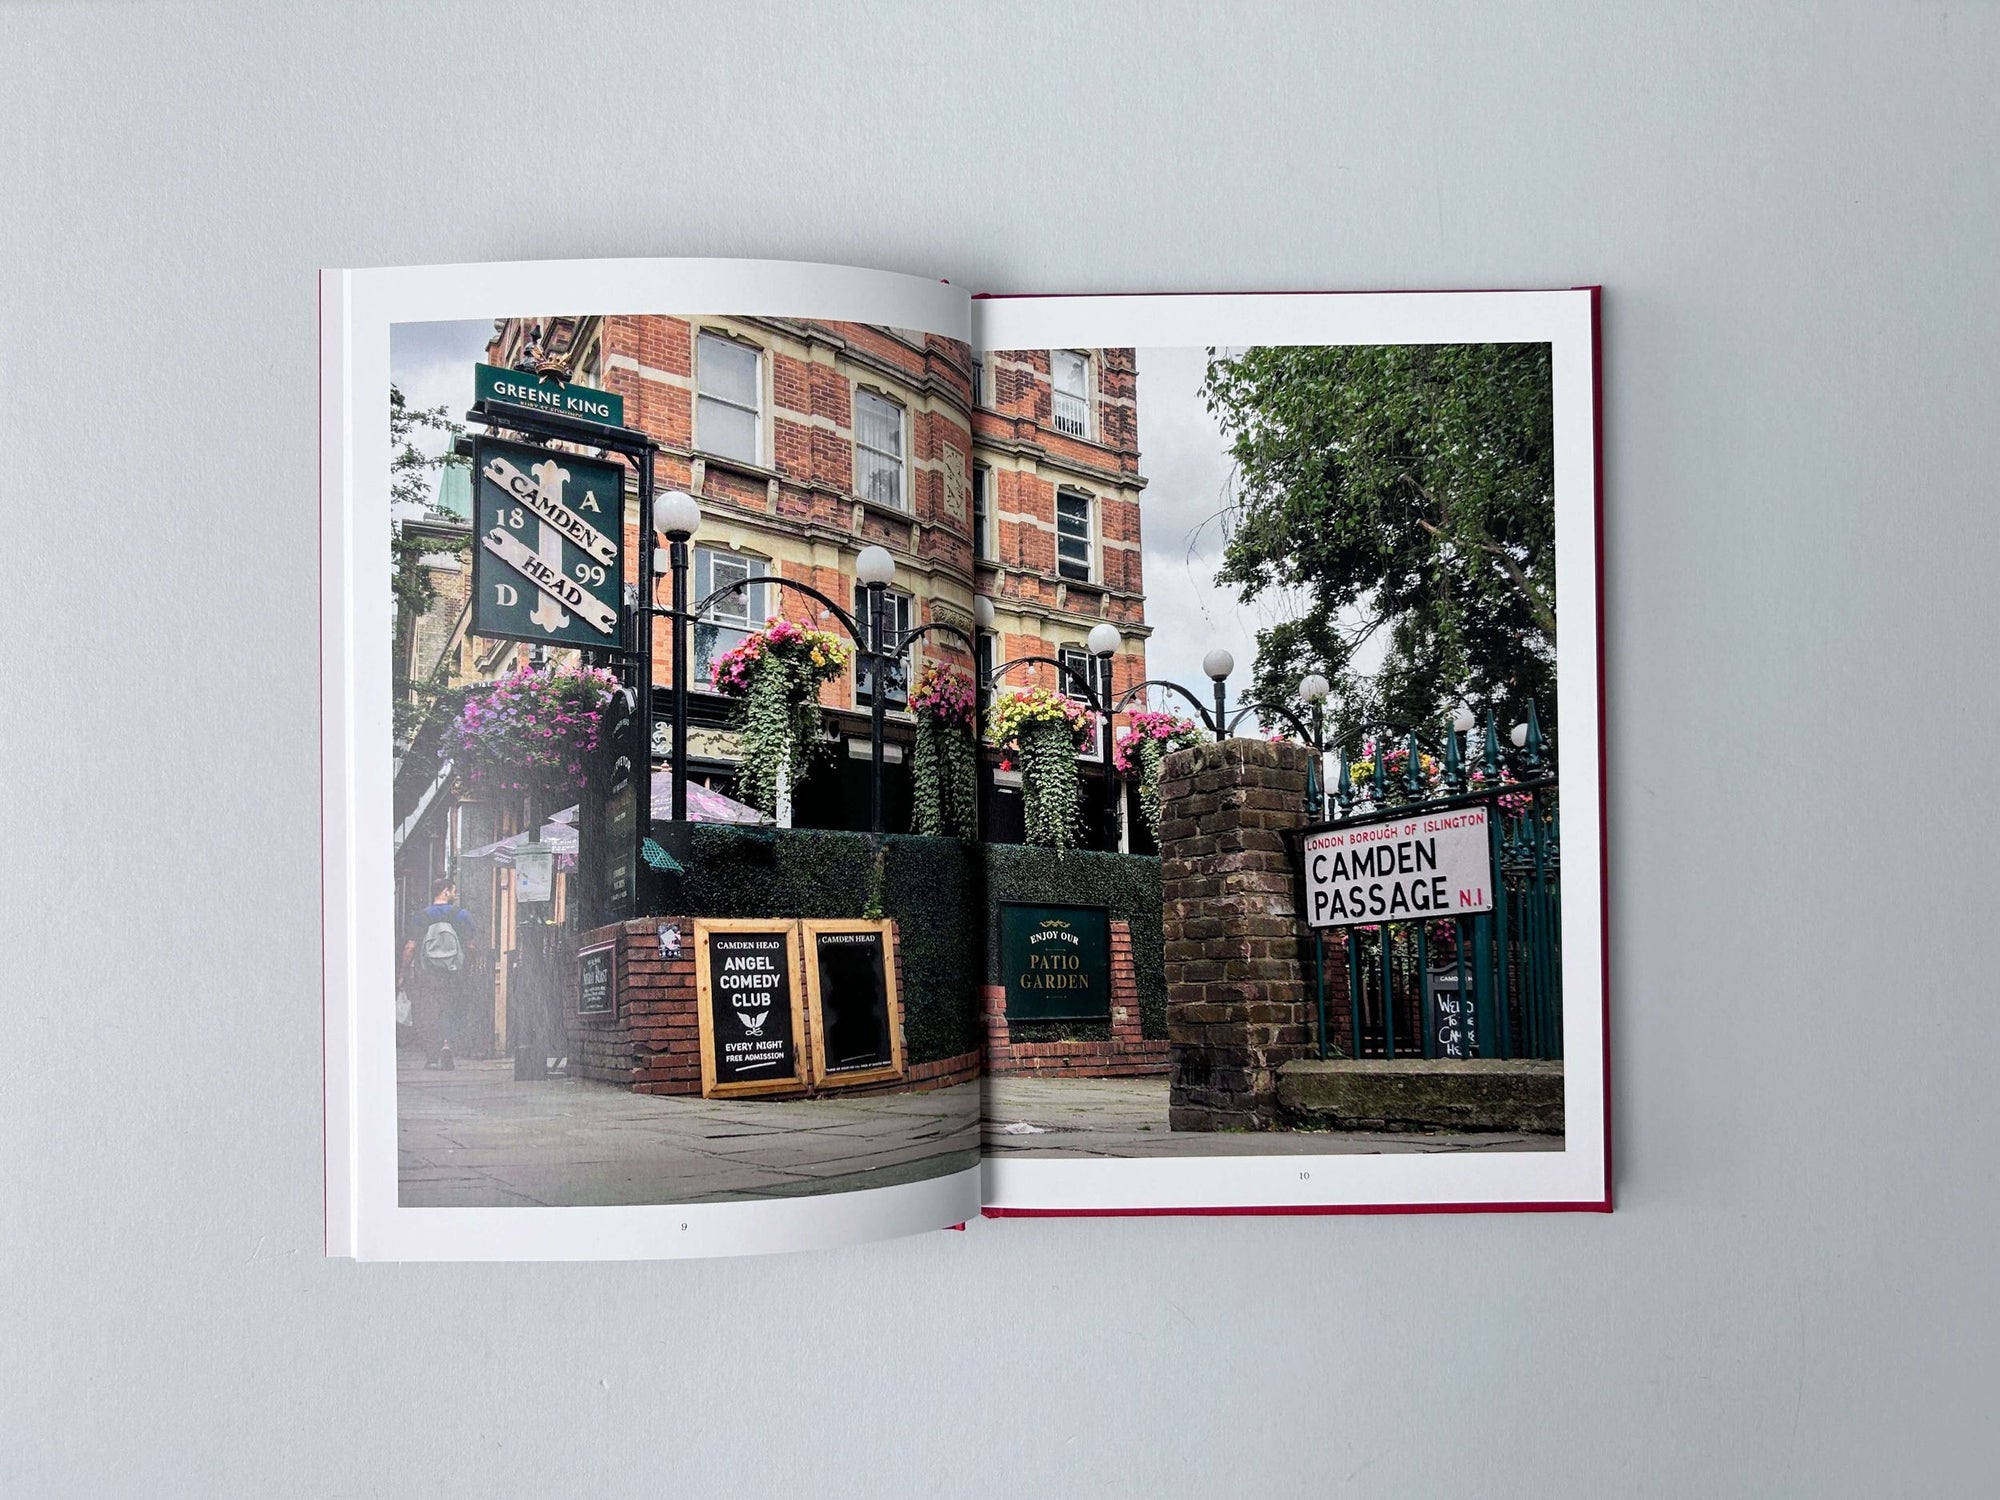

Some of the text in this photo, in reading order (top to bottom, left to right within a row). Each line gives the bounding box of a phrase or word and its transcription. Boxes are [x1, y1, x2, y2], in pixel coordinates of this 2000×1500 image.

[493, 381, 610, 418] GREENE KING
[579, 490, 602, 513] A
[495, 506, 525, 530] 18
[510, 475, 599, 548] CAMDEN
[521, 555, 583, 606] HEAD
[575, 563, 606, 587] 99
[495, 583, 519, 607] D
[1307, 813, 1485, 851] LONDON BOROUGH OF ISLINGTON
[1312, 837, 1437, 884] CAMDEN
[1313, 876, 1450, 921] PASSAGE
[716, 940, 780, 950] CAMDEN HEAD
[822, 934, 876, 943] CAMDEN HEAD
[1029, 930, 1080, 946] ENJOY OUR
[723, 956, 775, 971] ANGEL
[1029, 954, 1080, 970] PATIO
[719, 972, 781, 989] COMEDY
[1020, 974, 1090, 989] GARDEN
[731, 992, 772, 1007] CLUB
[725, 1040, 784, 1052] EVERY NIGHT
[726, 1052, 785, 1062] FREE ADMISSION
[1299, 1171, 1310, 1180] 10
[680, 1222, 688, 1231] 9
